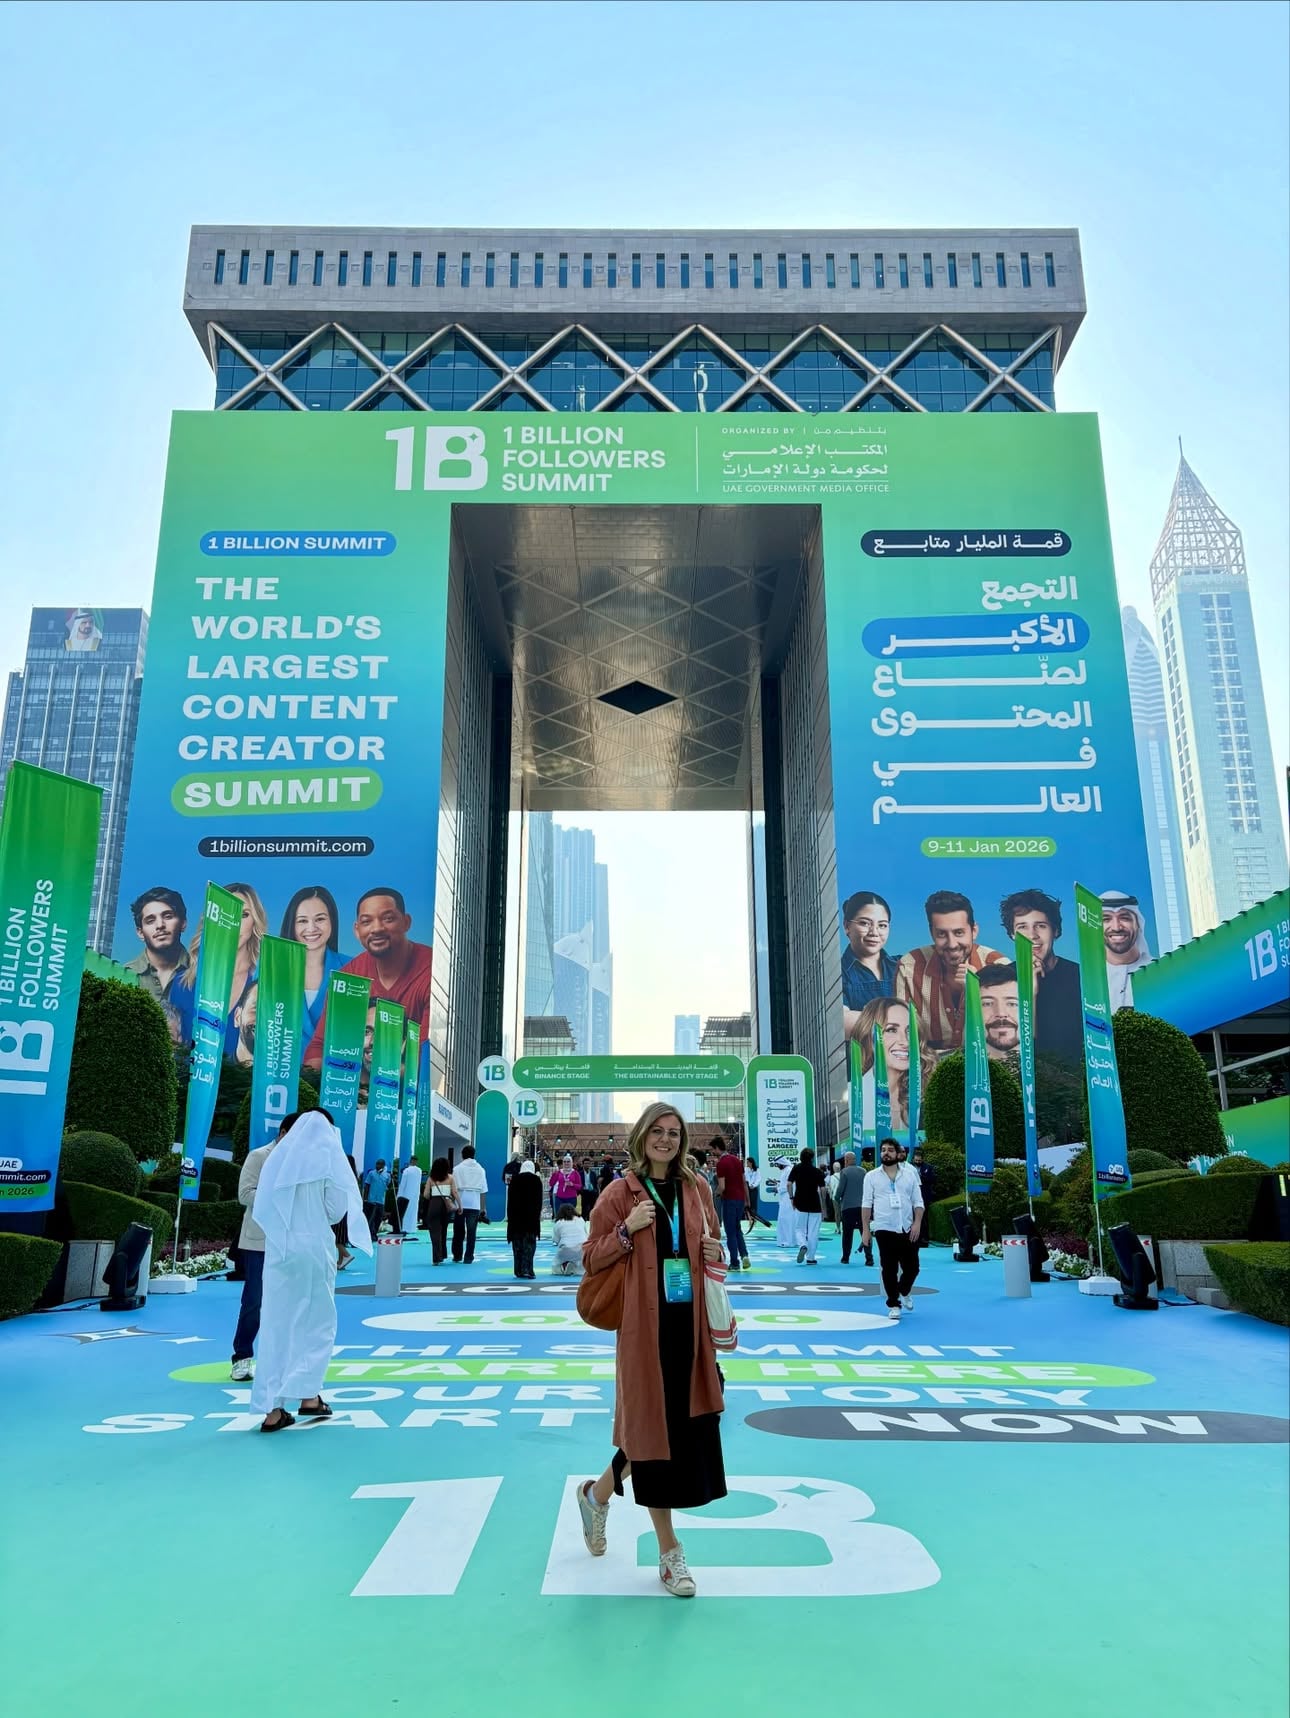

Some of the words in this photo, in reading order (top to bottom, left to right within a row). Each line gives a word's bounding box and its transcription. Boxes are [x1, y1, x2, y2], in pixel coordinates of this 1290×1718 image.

[503, 427, 512, 444] 1
[522, 427, 624, 444] BILLION
[385, 425, 488, 491] 1B
[503, 449, 666, 469] FOLLOWERS
[722, 444, 822, 461] الإعلامي
[825, 444, 888, 458] المكتب
[723, 464, 789, 479] الإمارات
[793, 464, 826, 479] دولة
[831, 463, 888, 479] لحكومة
[502, 473, 613, 492] SUMMIT
[723, 484, 743, 492] UAE
[745, 484, 816, 492] GOVERNMENT
[819, 484, 852, 492] MEDIA
[855, 484, 889, 492] OFFICE
[208, 537, 219, 549] 1
[223, 537, 300, 549] BILLION
[304, 537, 386, 549] SUMMIT
[873, 536, 951, 554] متابع
[956, 534, 1008, 552] المليار
[1012, 534, 1063, 549] قمة
[195, 577, 279, 600] THE
[981, 575, 1078, 611] التجمع
[191, 615, 381, 640] WORLD'S
[881, 614, 1077, 655] الأكبر
[187, 655, 389, 680] LARGEST
[182, 695, 398, 720] CONTENT
[871, 701, 1092, 737] المحتوى
[178, 736, 385, 761] CREATOR
[872, 737, 1097, 787] في
[183, 777, 370, 808] SUMMIT
[872, 785, 1102, 825] العالم
[210, 839, 367, 854] 1billionsummit.com
[928, 841, 965, 853] 9-11
[970, 840, 1000, 854] Jan
[1004, 840, 1050, 853] 2026
[0, 907, 27, 993] BILLION
[18, 879, 54, 1009] FOLLOWERS
[1244, 929, 1278, 981] 1B
[42, 923, 68, 1011] SUMMIT
[1022, 1000, 1033, 1078] FOLLOWERS
[280, 1027, 294, 1079] SUMMIT
[483, 1065, 505, 1080] 1B
[516, 1100, 538, 1116] 1B
[970, 1098, 991, 1138] 1B
[8, 1187, 34, 1196] 2026
[544, 1344, 1016, 1358] SMMIT
[759, 1362, 1098, 1381] HERE
[724, 1385, 1094, 1407] TORY
[840, 1410, 1209, 1436] NOW
[350, 1474, 943, 1597] 1B
